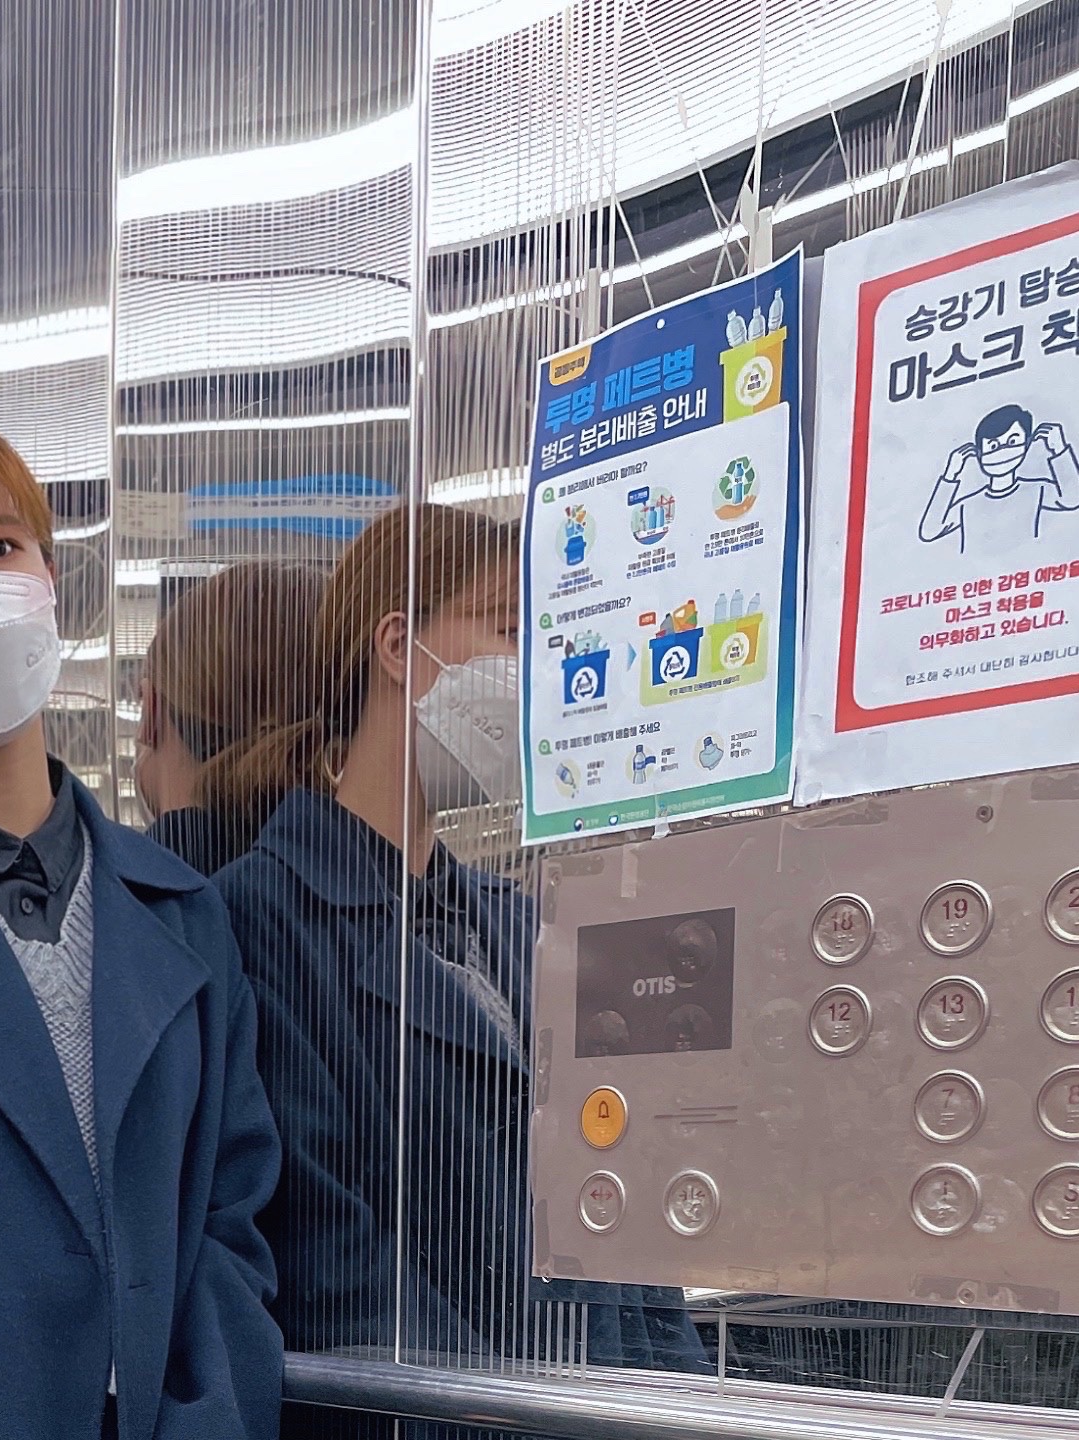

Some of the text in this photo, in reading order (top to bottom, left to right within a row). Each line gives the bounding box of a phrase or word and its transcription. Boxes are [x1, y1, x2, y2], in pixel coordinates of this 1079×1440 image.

[904, 280, 1005, 342] 승강기
[888, 325, 1025, 403] 마스크
[545, 344, 695, 434] 투명 페트병
[540, 387, 707, 471] 별도 분리배출 안내
[880, 586, 957, 615] 코로나19로
[962, 578, 993, 599] 인한
[997, 571, 1030, 592] 감염
[945, 591, 1045, 624] 마스크 착용을
[919, 610, 1069, 651] 의무화하고 있습니다.
[905, 671, 939, 686] 협조해
[980, 657, 1015, 673] 대단히
[638, 721, 661, 735] 주세요
[942, 898, 968, 920] 19
[1069, 887, 1079, 908] 2
[632, 975, 676, 997] OTIS
[828, 1002, 851, 1022] 12
[939, 993, 965, 1015] 13
[941, 1088, 954, 1109] 7
